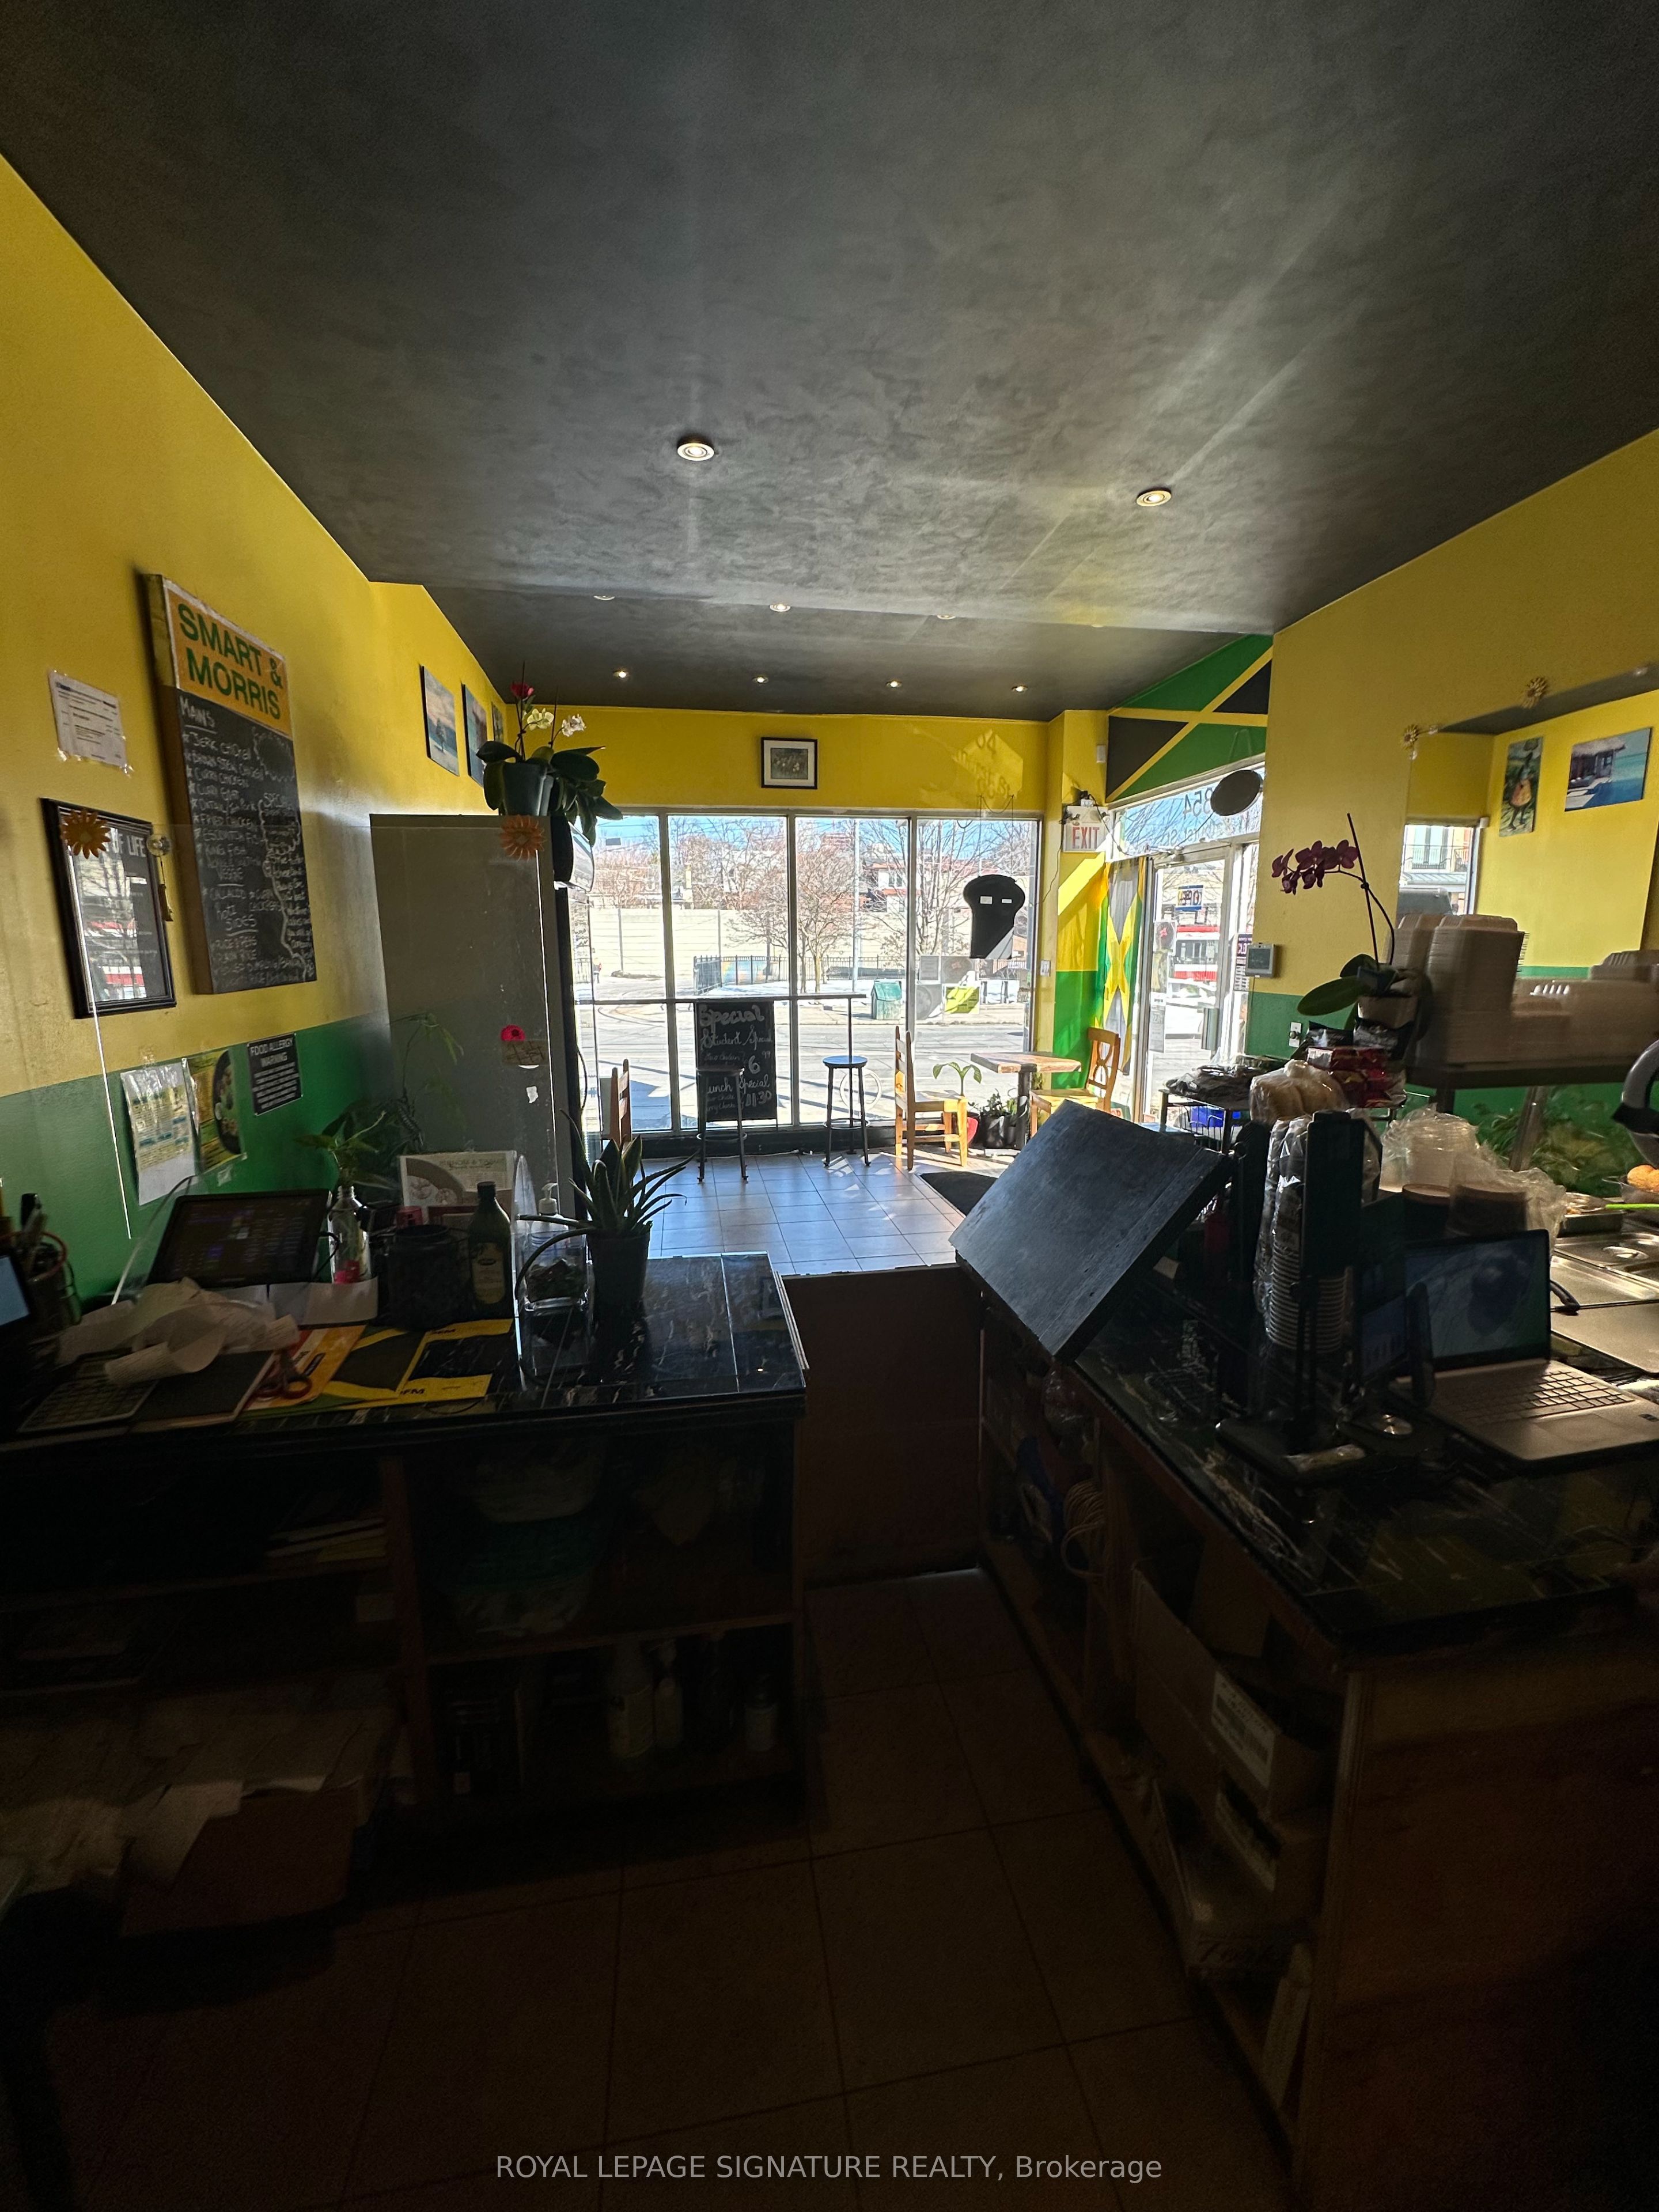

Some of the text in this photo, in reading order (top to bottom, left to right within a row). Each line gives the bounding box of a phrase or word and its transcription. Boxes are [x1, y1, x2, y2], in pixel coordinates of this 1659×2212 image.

[178, 603, 283, 690] SMART &
[186, 647, 281, 720] MORRIS
[179, 695, 215, 728] MAINS
[127, 835, 146, 857] LIFE
[1072, 825, 1100, 850] EXIT
[699, 1004, 765, 1035] Special
[250, 1044, 269, 1056] FOOD
[700, 1028, 742, 1051] Student
[748, 1055, 760, 1074] 6
[706, 1077, 733, 1094] unch
